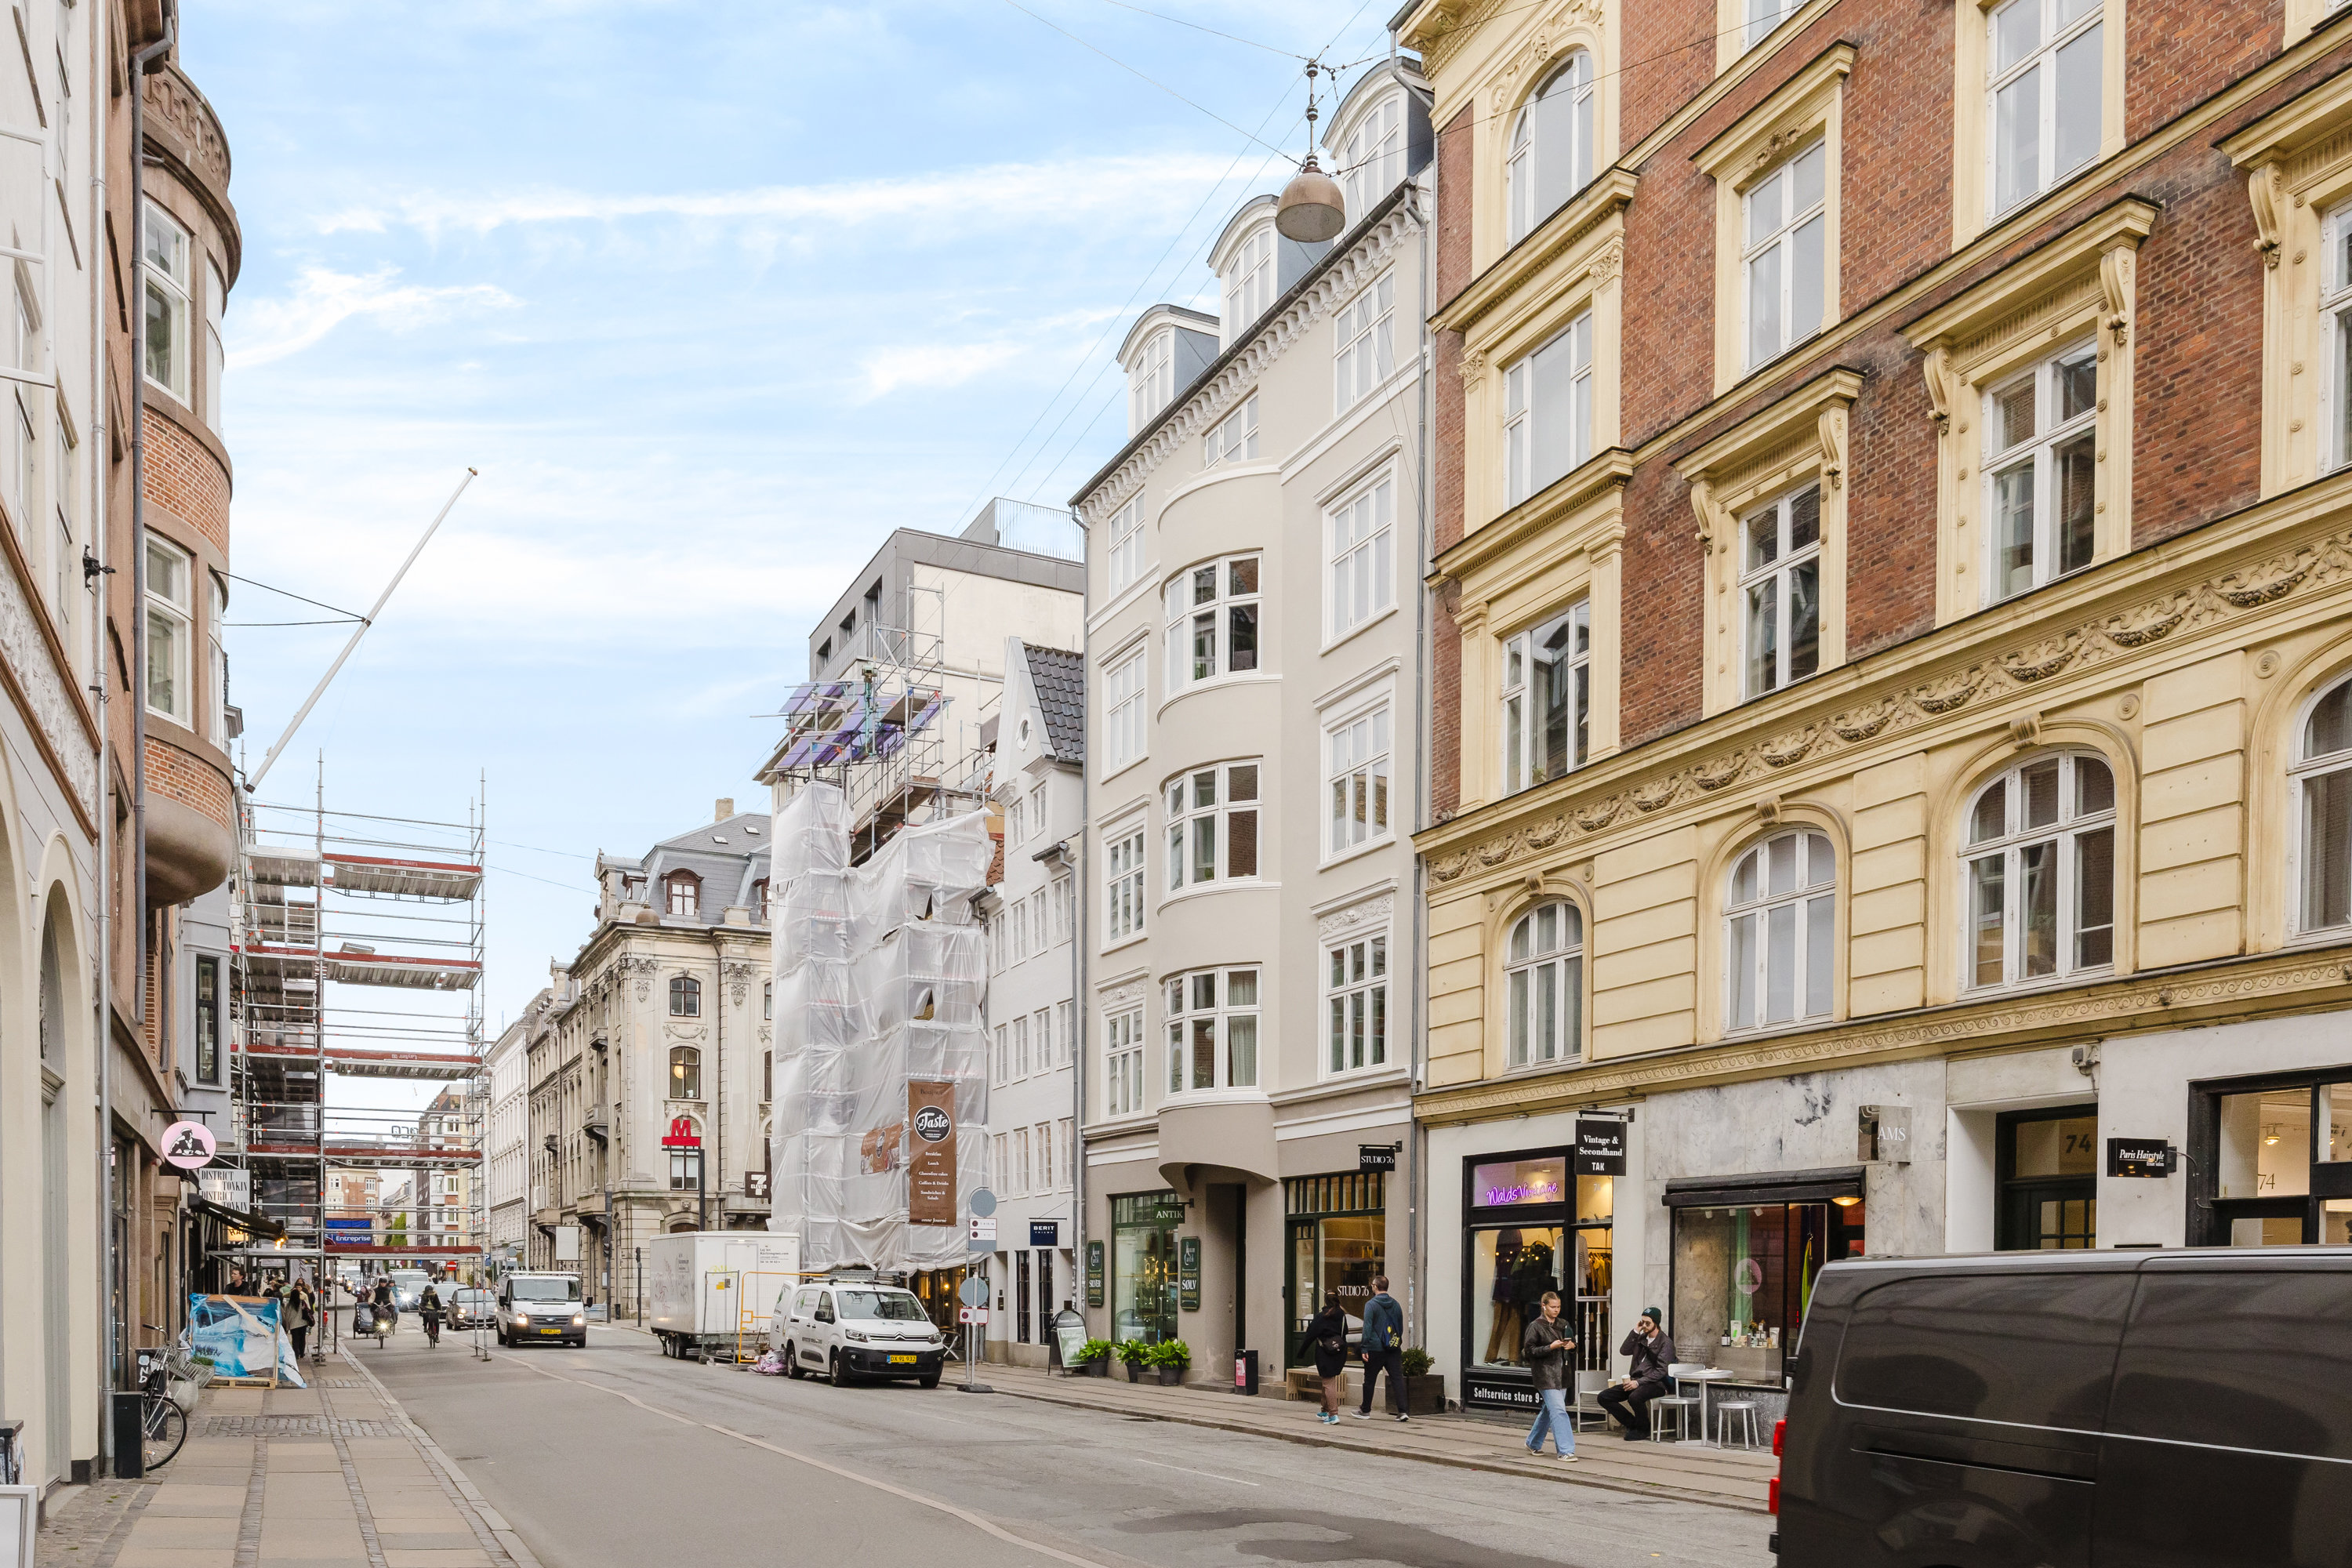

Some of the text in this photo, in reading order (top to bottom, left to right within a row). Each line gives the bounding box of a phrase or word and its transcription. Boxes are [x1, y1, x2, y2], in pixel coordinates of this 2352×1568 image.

[916, 1112, 949, 1131] Taste
[1583, 1134, 1619, 1146] Vintage &
[1877, 1127, 1906, 1142] AMS
[2066, 1134, 2092, 1153] 74
[1579, 1146, 1623, 1157] Secondhand
[2119, 1149, 2165, 1162] Paris Hairstyle
[1360, 1156, 1386, 1164] STUDIO
[1592, 1162, 1605, 1171] TAK
[201, 1170, 234, 1181] DISTRICT
[2258, 1173, 2275, 1189] 74
[223, 1181, 248, 1191] TONKIN
[751, 1174, 767, 1196] 7
[202, 1191, 234, 1200] DISTRICT
[1486, 1181, 1559, 1206] Walds Vintage
[1156, 1210, 1183, 1218] ANTIK
[1181, 1279, 1197, 1290] SØLV
[1337, 1285, 1370, 1297] STUDIO 76
[1474, 1387, 1512, 1400] Selfservice
[1514, 1392, 1533, 1403] store
